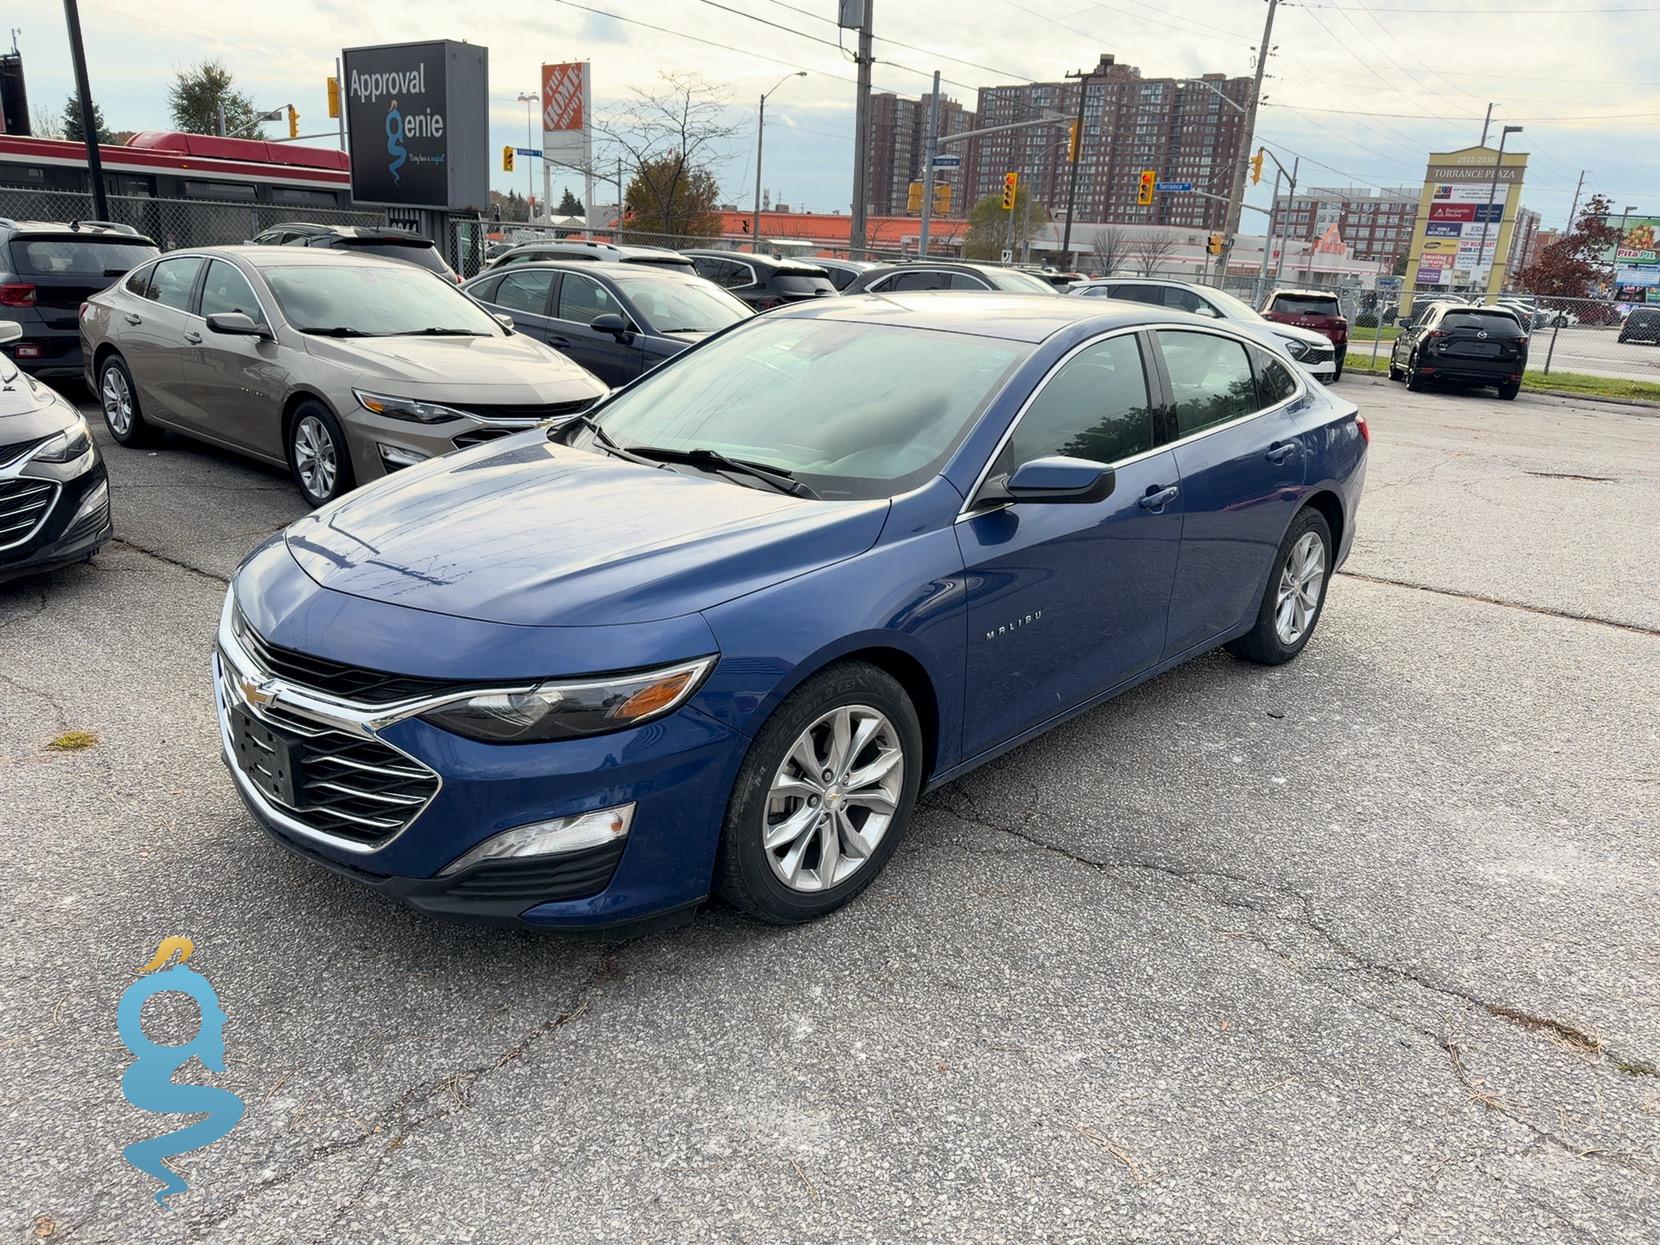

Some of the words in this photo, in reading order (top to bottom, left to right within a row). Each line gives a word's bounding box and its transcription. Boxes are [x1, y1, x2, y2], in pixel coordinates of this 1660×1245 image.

[350, 62, 426, 103] Approval
[544, 63, 583, 130] HOME
[545, 67, 563, 96] THE
[560, 87, 584, 129] DEPOT
[1434, 169, 1483, 178] TORRANCE
[1617, 249, 1638, 257] Pita
[1639, 250, 1657, 259] Pit
[985, 610, 1042, 641] MALIBU
